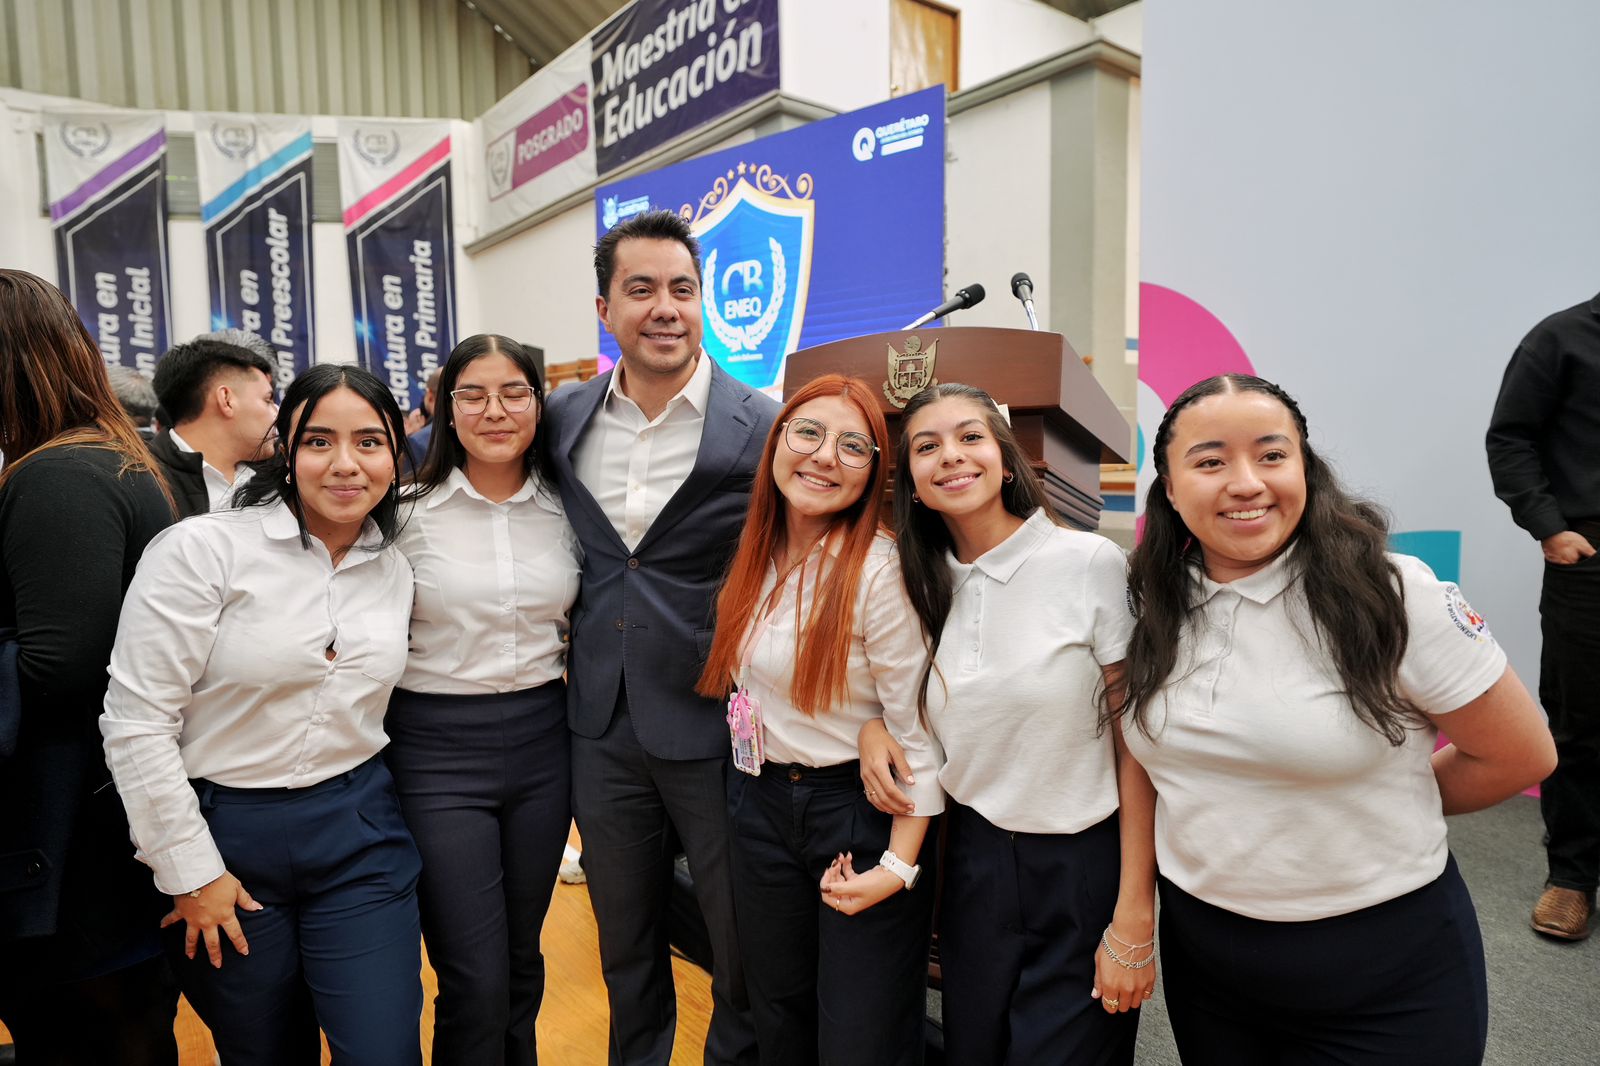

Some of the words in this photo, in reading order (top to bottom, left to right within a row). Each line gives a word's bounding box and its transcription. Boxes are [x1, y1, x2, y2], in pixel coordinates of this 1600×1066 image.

[603, 18, 763, 148] Educación
[517, 108, 584, 165] POSGRADO
[95, 271, 119, 309] en
[239, 269, 260, 306] en
[265, 207, 294, 347] Preescolar
[382, 274, 404, 311] en
[409, 239, 438, 349] Primaria
[125, 266, 154, 348] Inicial
[724, 296, 762, 320] ENEQ
